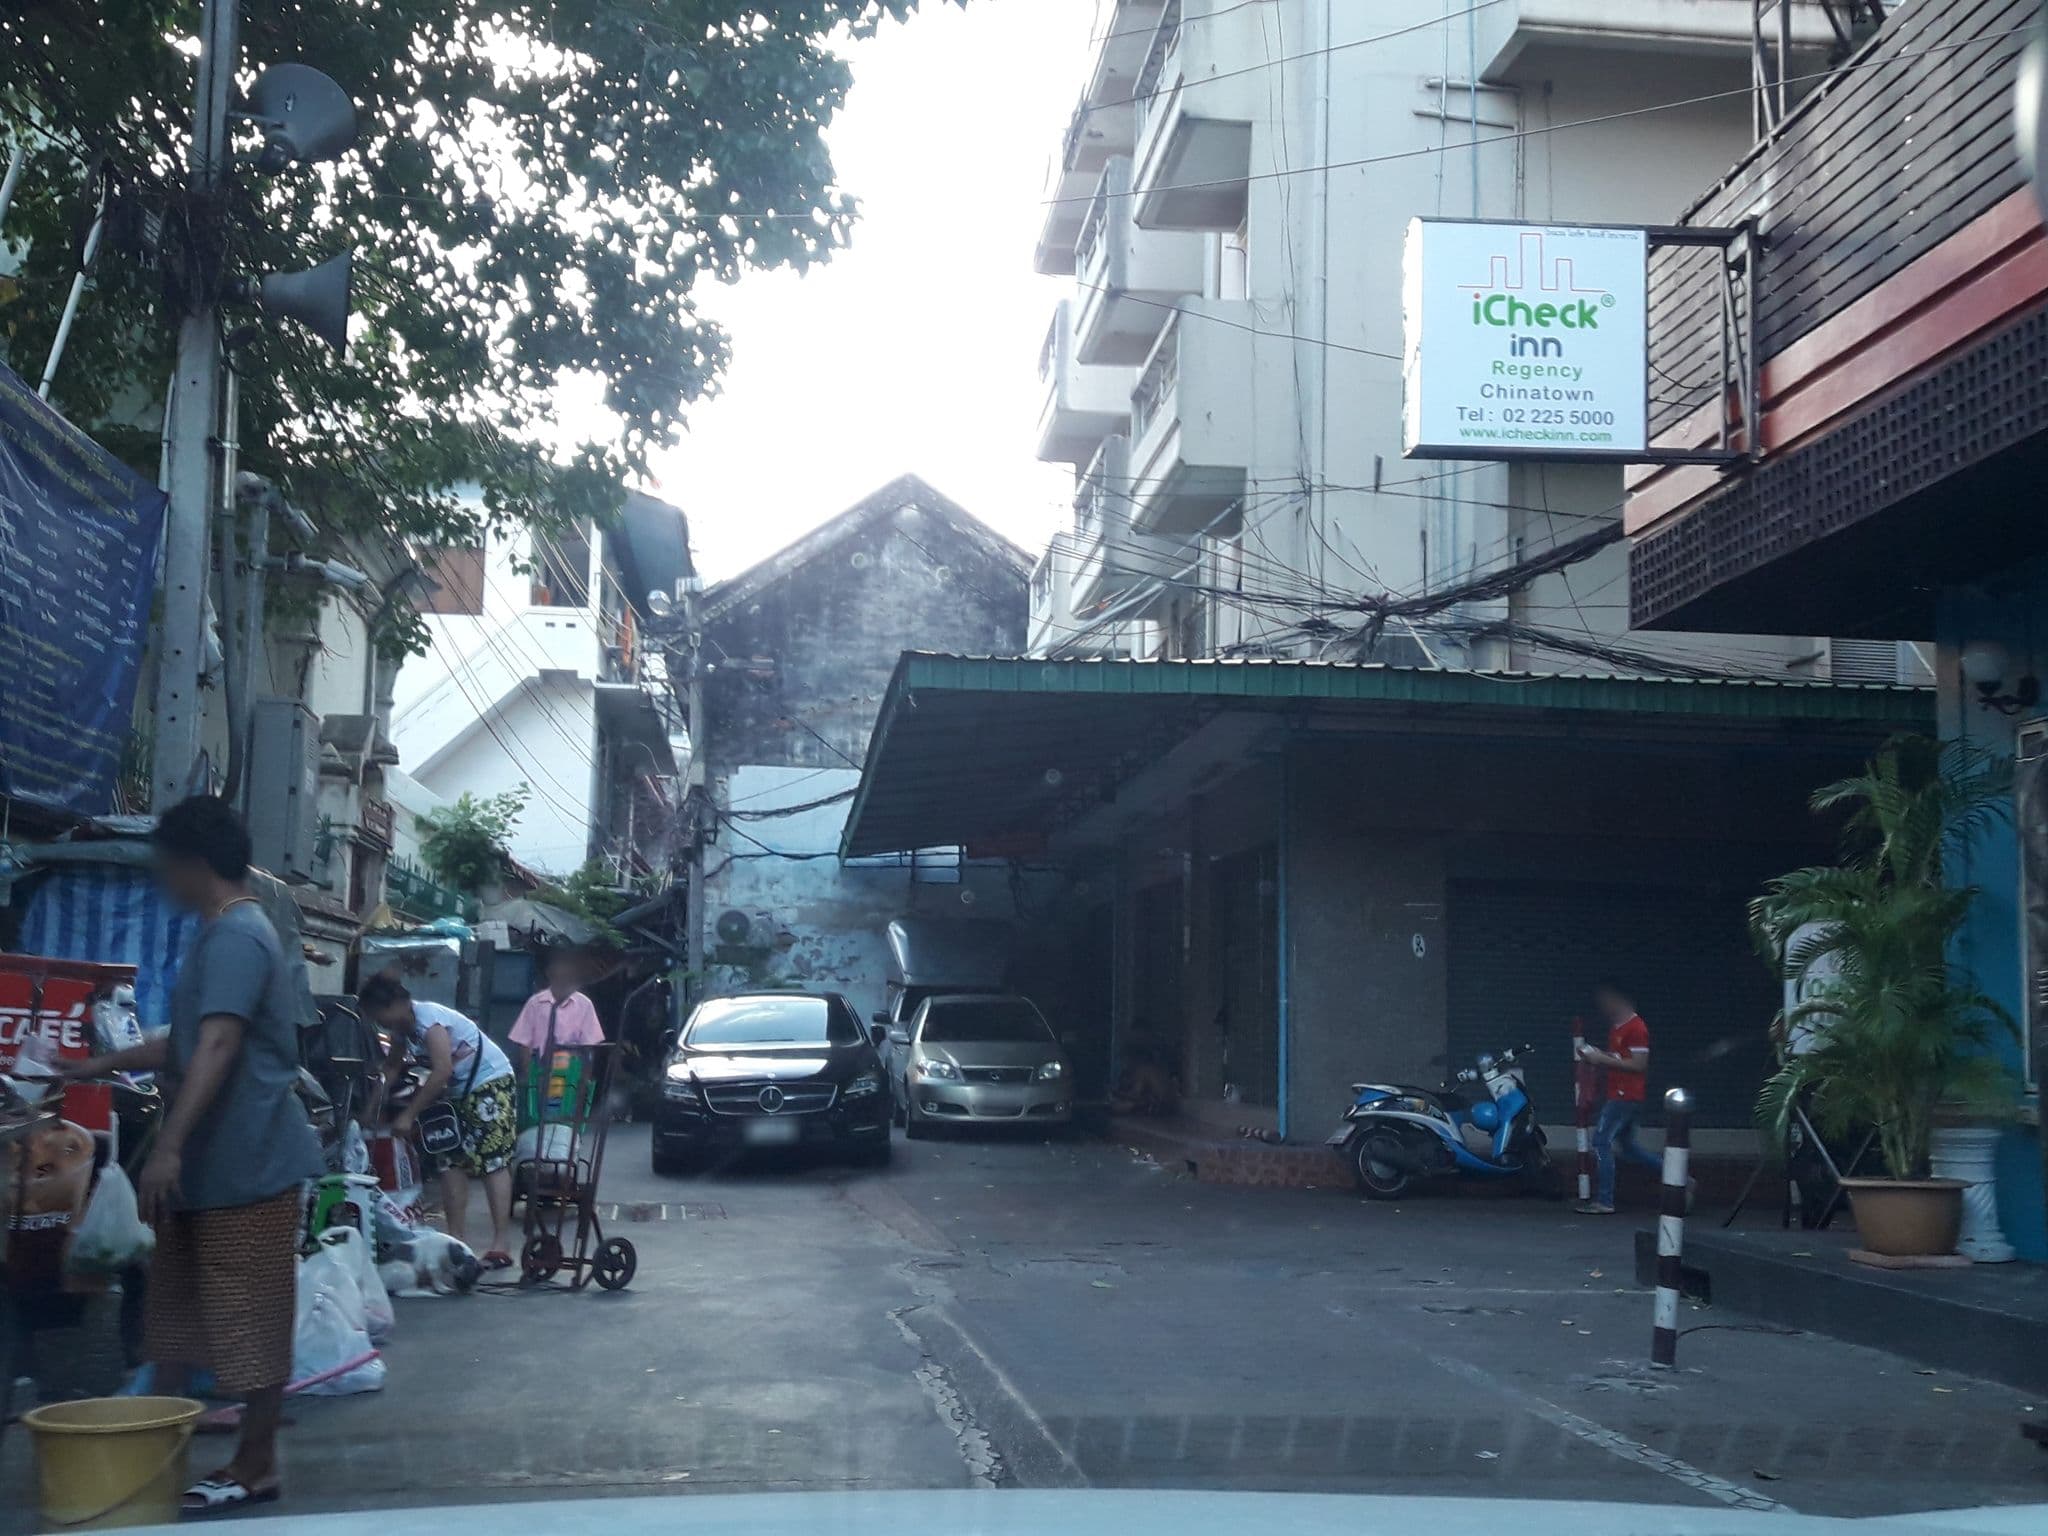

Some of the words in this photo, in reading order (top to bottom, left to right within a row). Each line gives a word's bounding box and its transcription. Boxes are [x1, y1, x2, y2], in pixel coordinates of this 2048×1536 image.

[1473, 292, 1599, 330] iCheck
[1509, 333, 1563, 358] inn
[1491, 360, 1583, 382] Regency
[1480, 383, 1594, 401] Chinatown
[1503, 408, 1525, 423] 02
[1530, 409, 1564, 424] 225
[1569, 410, 1614, 426] 5000
[1459, 427, 1613, 442] www.icheckinn.com
